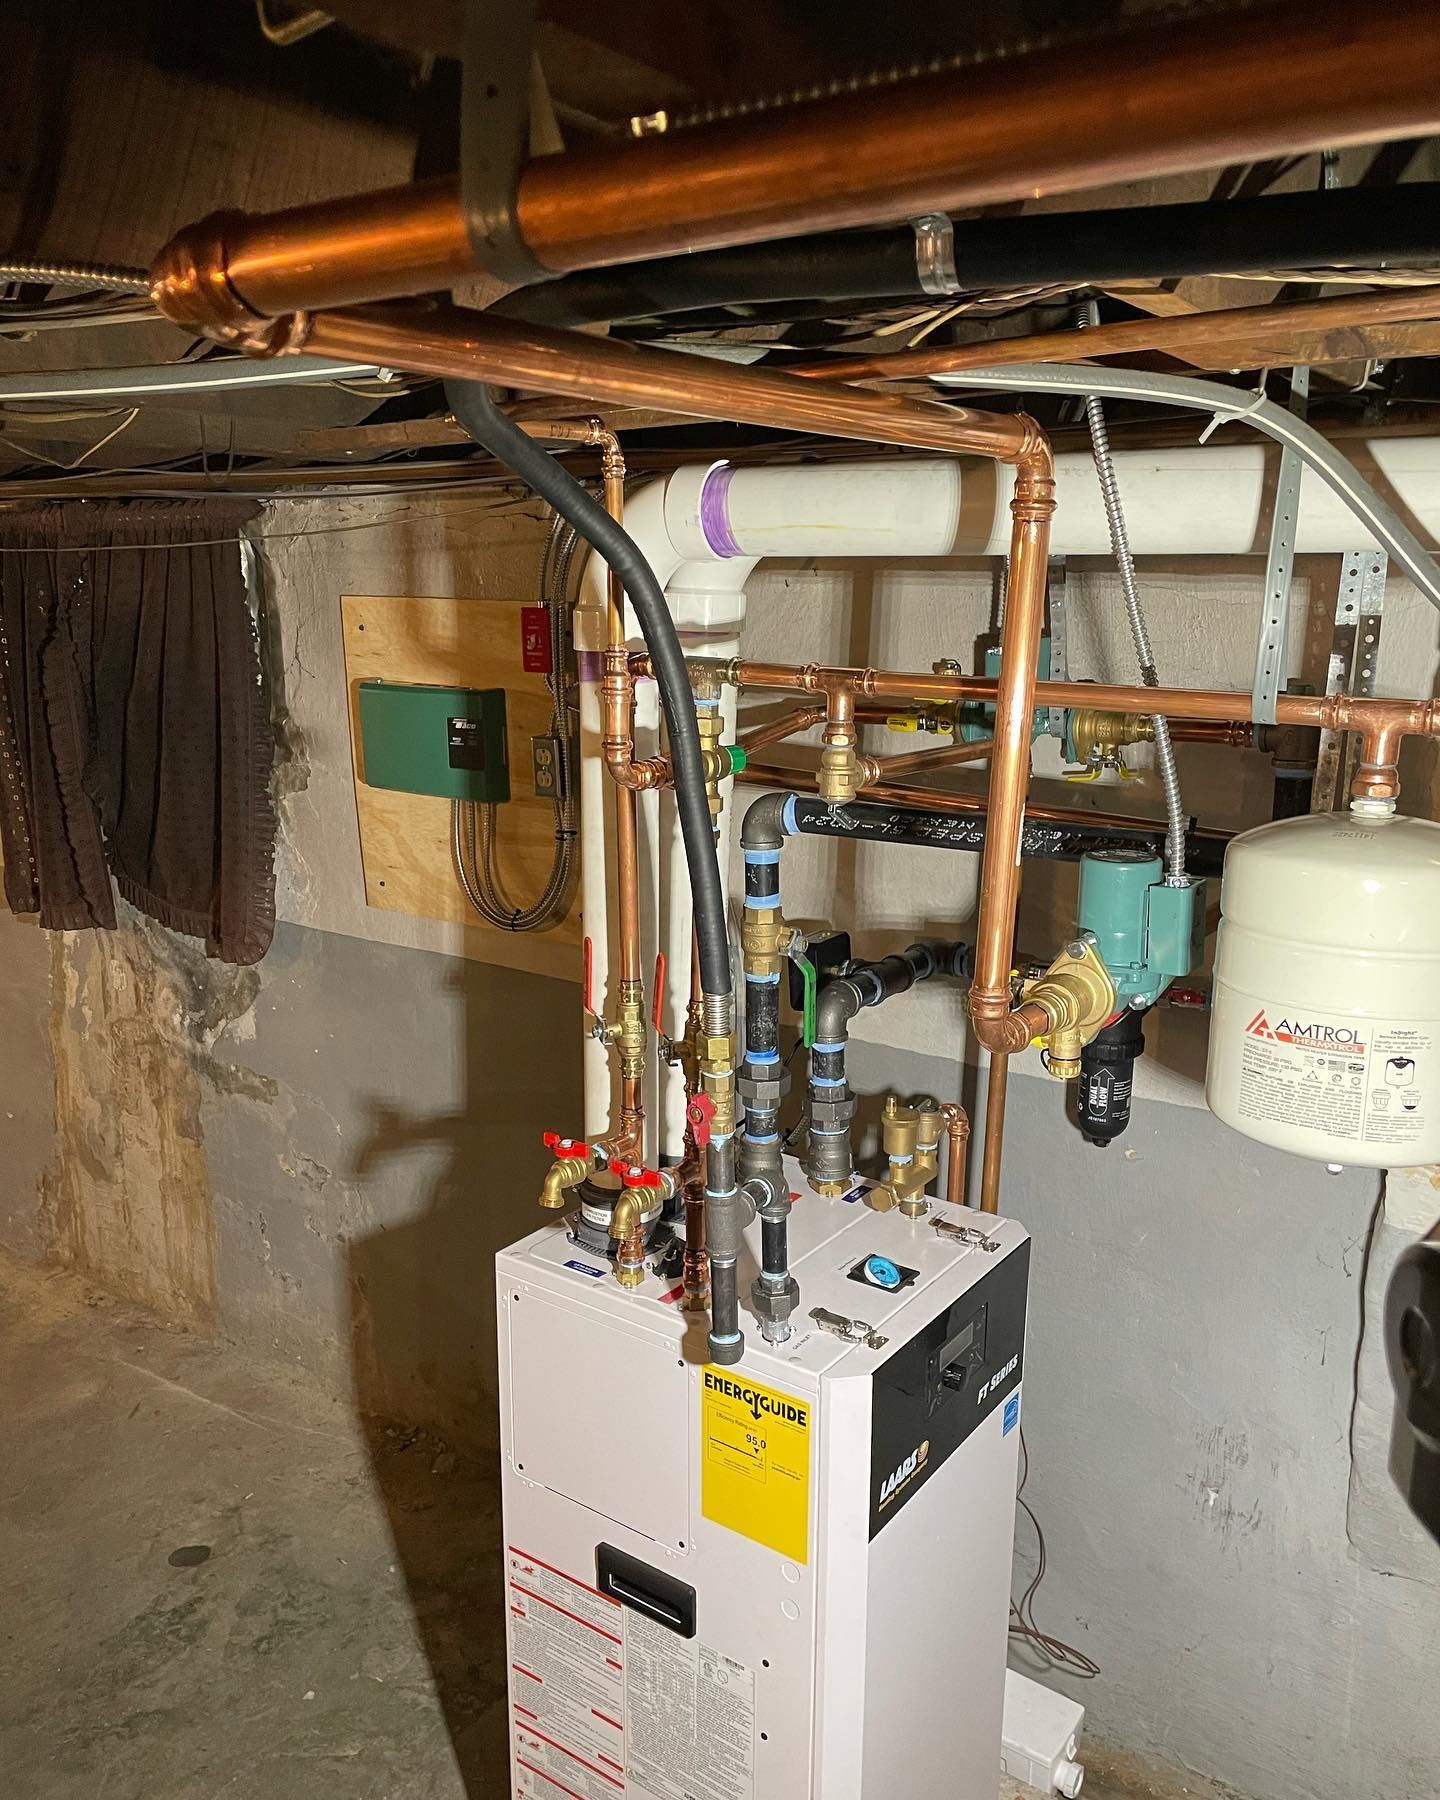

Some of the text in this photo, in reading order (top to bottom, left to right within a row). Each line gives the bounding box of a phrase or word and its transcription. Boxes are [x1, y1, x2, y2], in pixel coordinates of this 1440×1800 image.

[1275, 1018, 1367, 1045] AMTROL
[1090, 1085, 1098, 1105] DUAL
[1099, 1086, 1107, 1107] FLOW
[977, 1354, 1019, 1405] FT SERIES
[704, 1372, 807, 1427] ENERGYGUIDE
[745, 1433, 767, 1449] 95.0
[879, 1448, 919, 1504] LAARS
